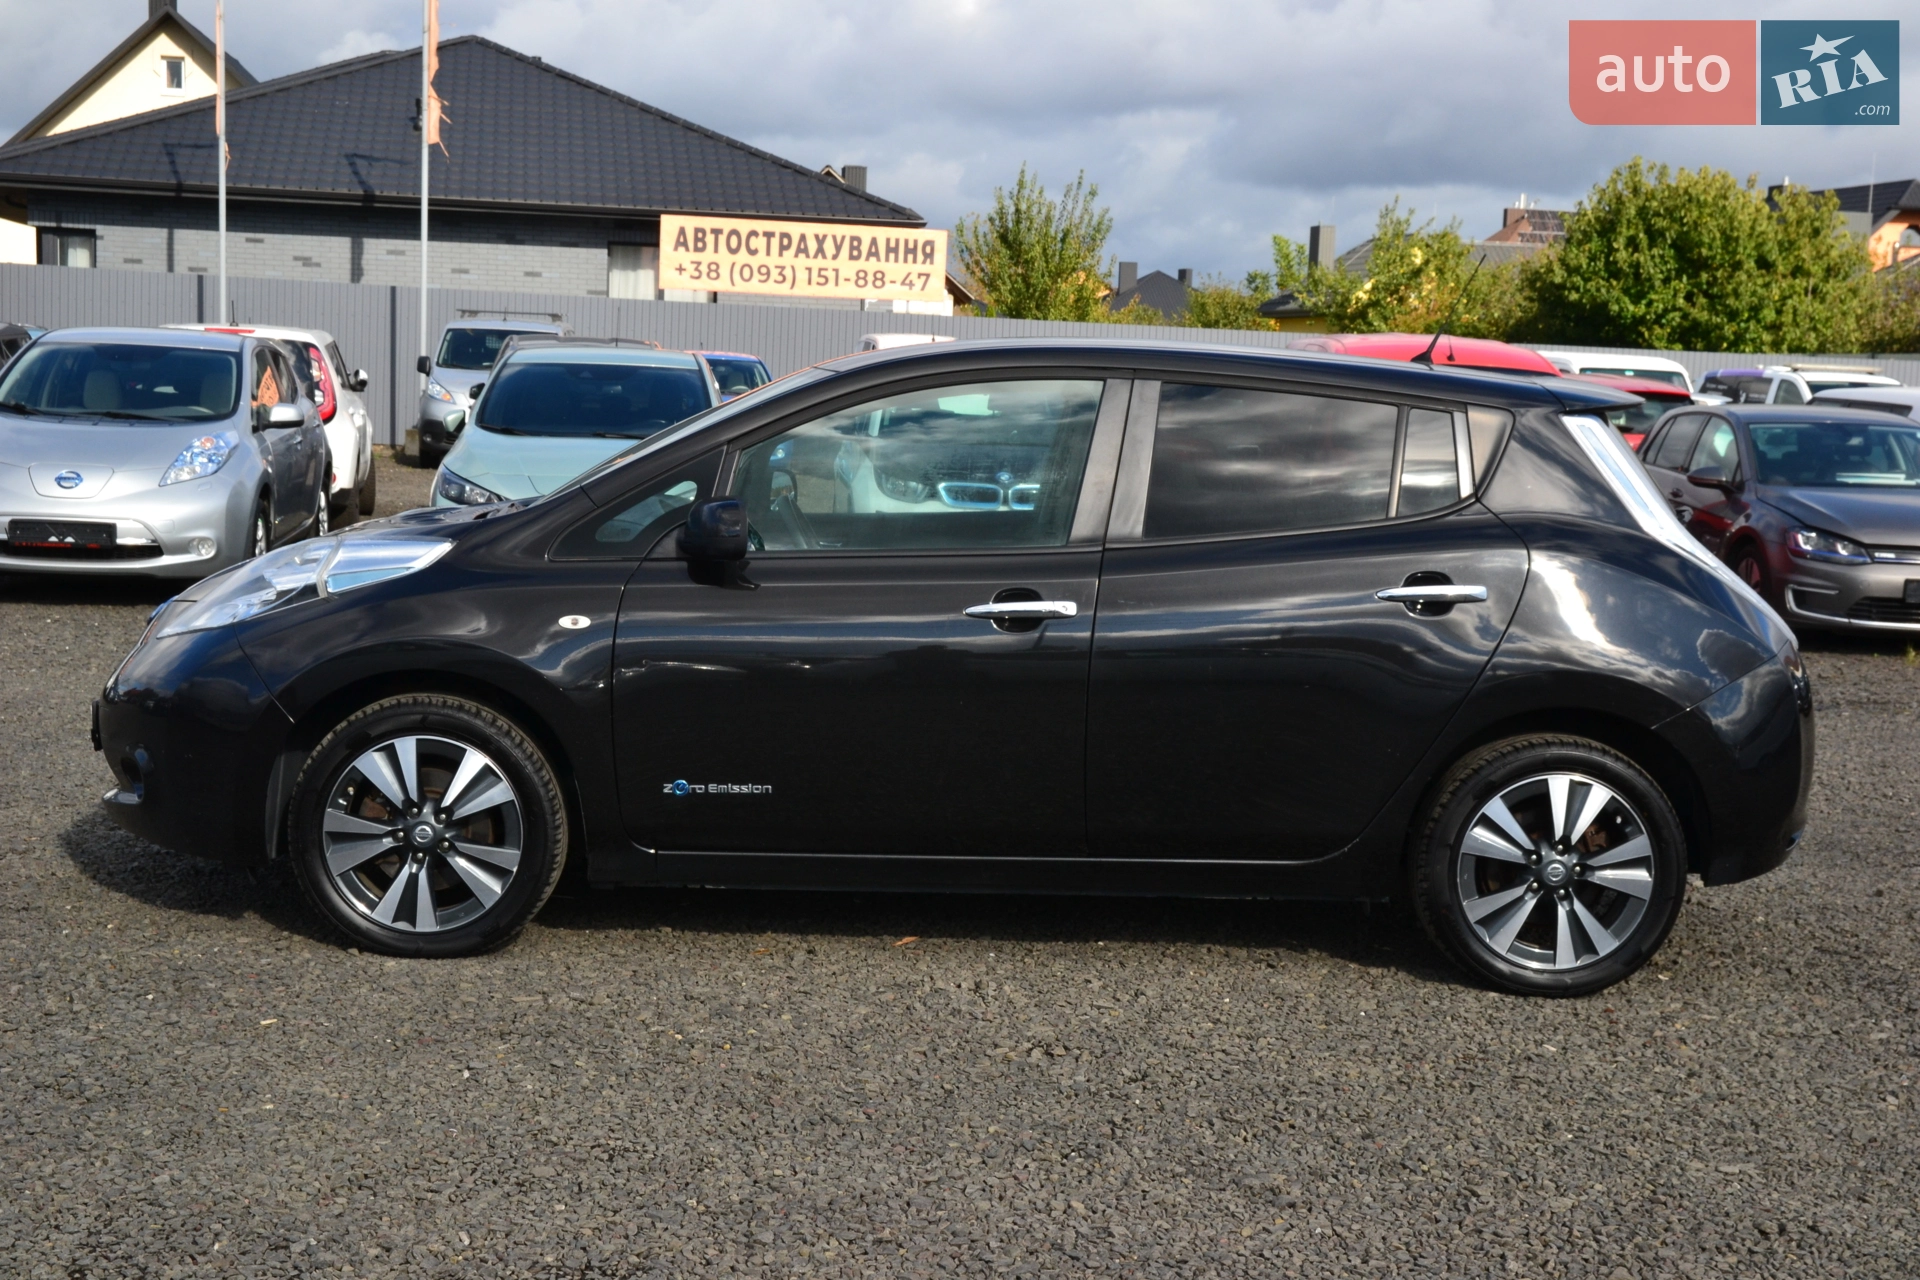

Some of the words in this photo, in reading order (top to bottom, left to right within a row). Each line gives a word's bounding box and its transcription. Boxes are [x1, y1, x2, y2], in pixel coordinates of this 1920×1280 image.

[673, 226, 935, 265] АВТОСТРАХУВАННЯ
[674, 261, 721, 281] +38
[729, 261, 797, 290] (093)
[804, 266, 931, 292] 151-88-47
